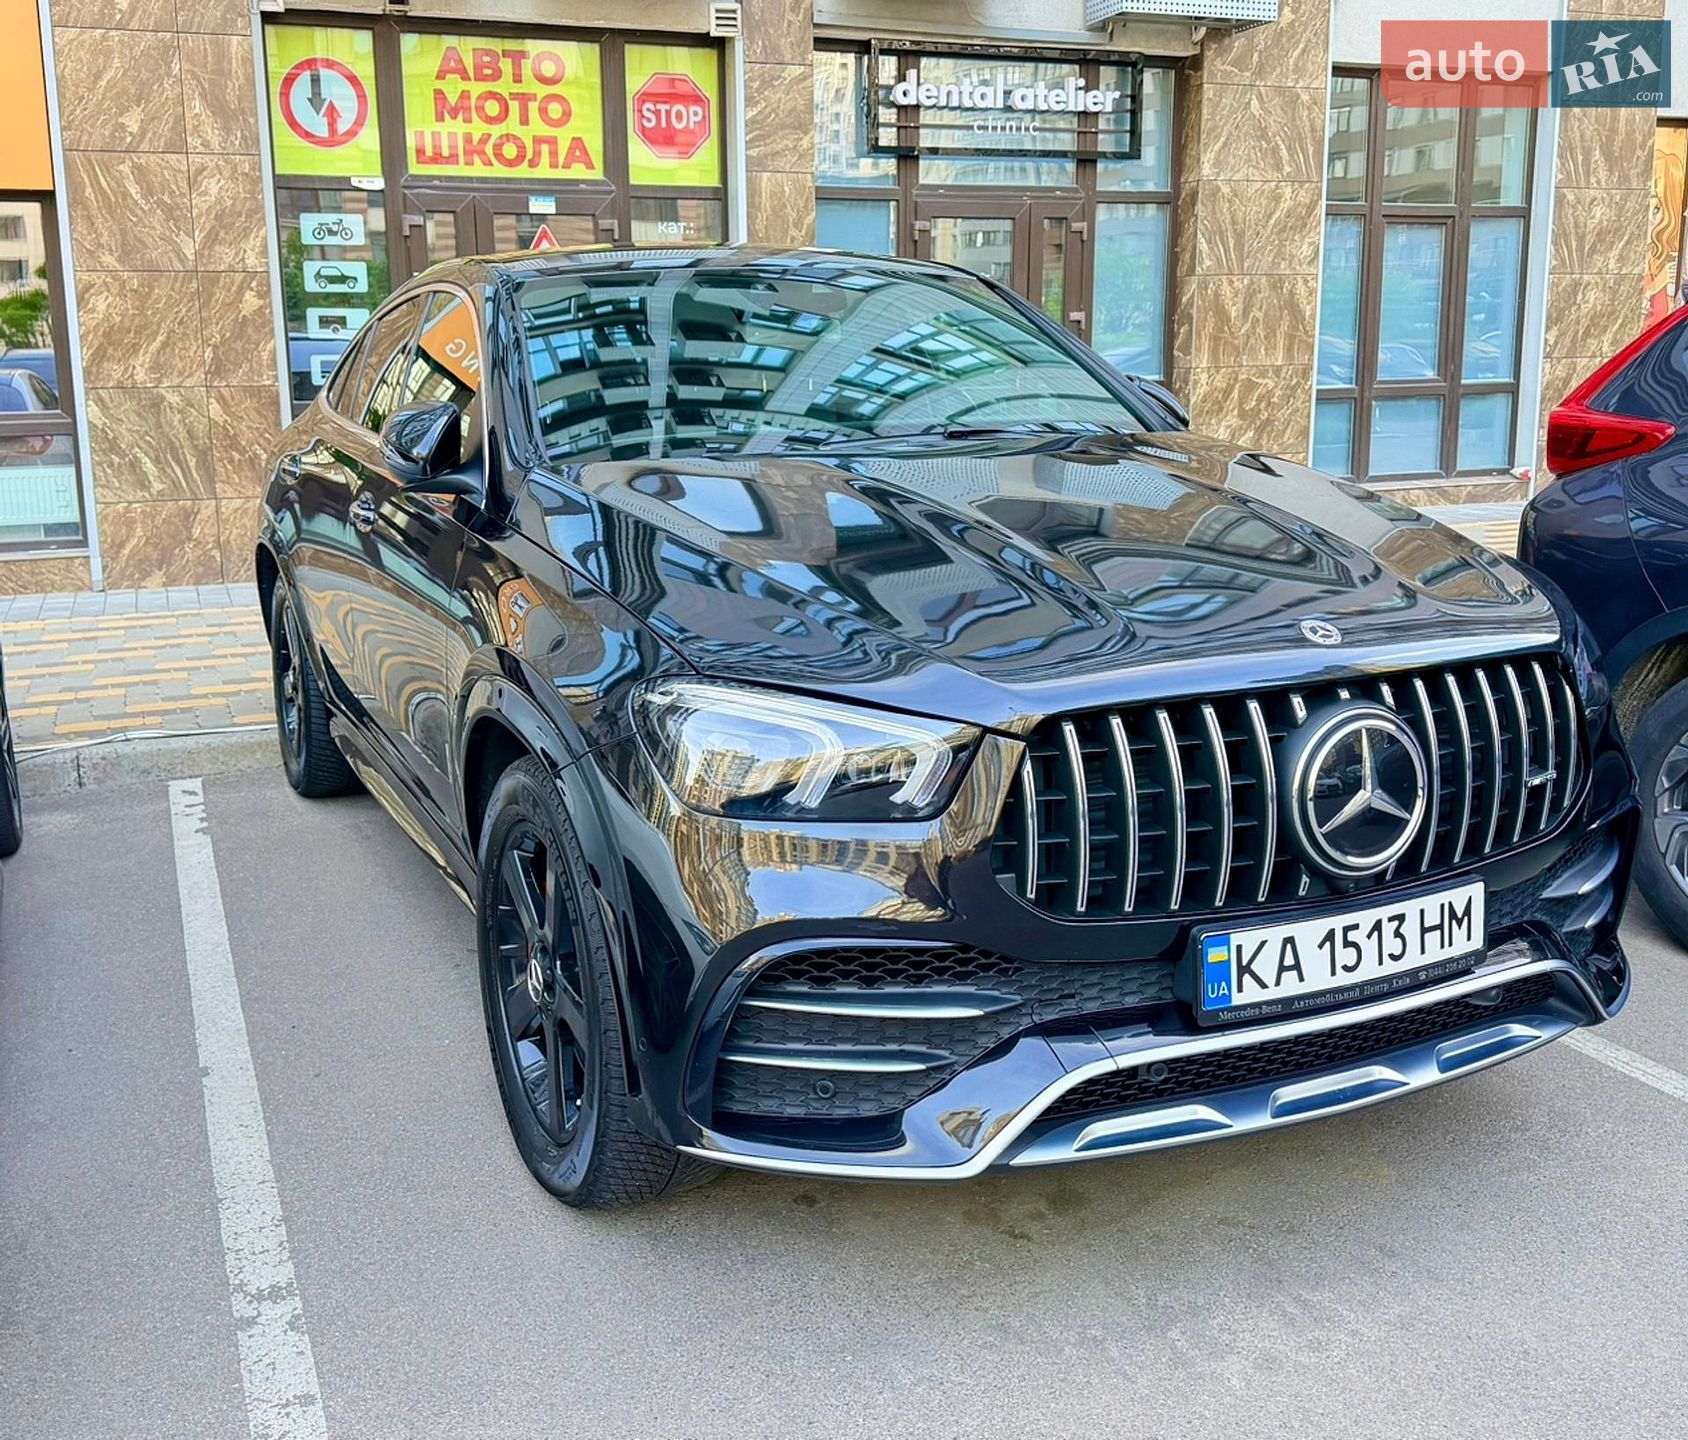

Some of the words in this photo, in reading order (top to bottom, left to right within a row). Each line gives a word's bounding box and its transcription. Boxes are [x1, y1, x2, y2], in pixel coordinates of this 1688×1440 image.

[435, 47, 565, 86] АВТО
[433, 89, 572, 128] МОТО
[890, 68, 1003, 109] dental
[1009, 77, 1121, 112] atelier
[641, 103, 703, 129] STOP
[973, 116, 1040, 136] clinic
[415, 130, 596, 170] ШКОЛА
[1236, 936, 1305, 994] KA
[1317, 912, 1407, 977] 1513
[1419, 895, 1472, 955] HM
[1208, 982, 1229, 998] UA
[1218, 1004, 1282, 1021] Mercedes-Benz
